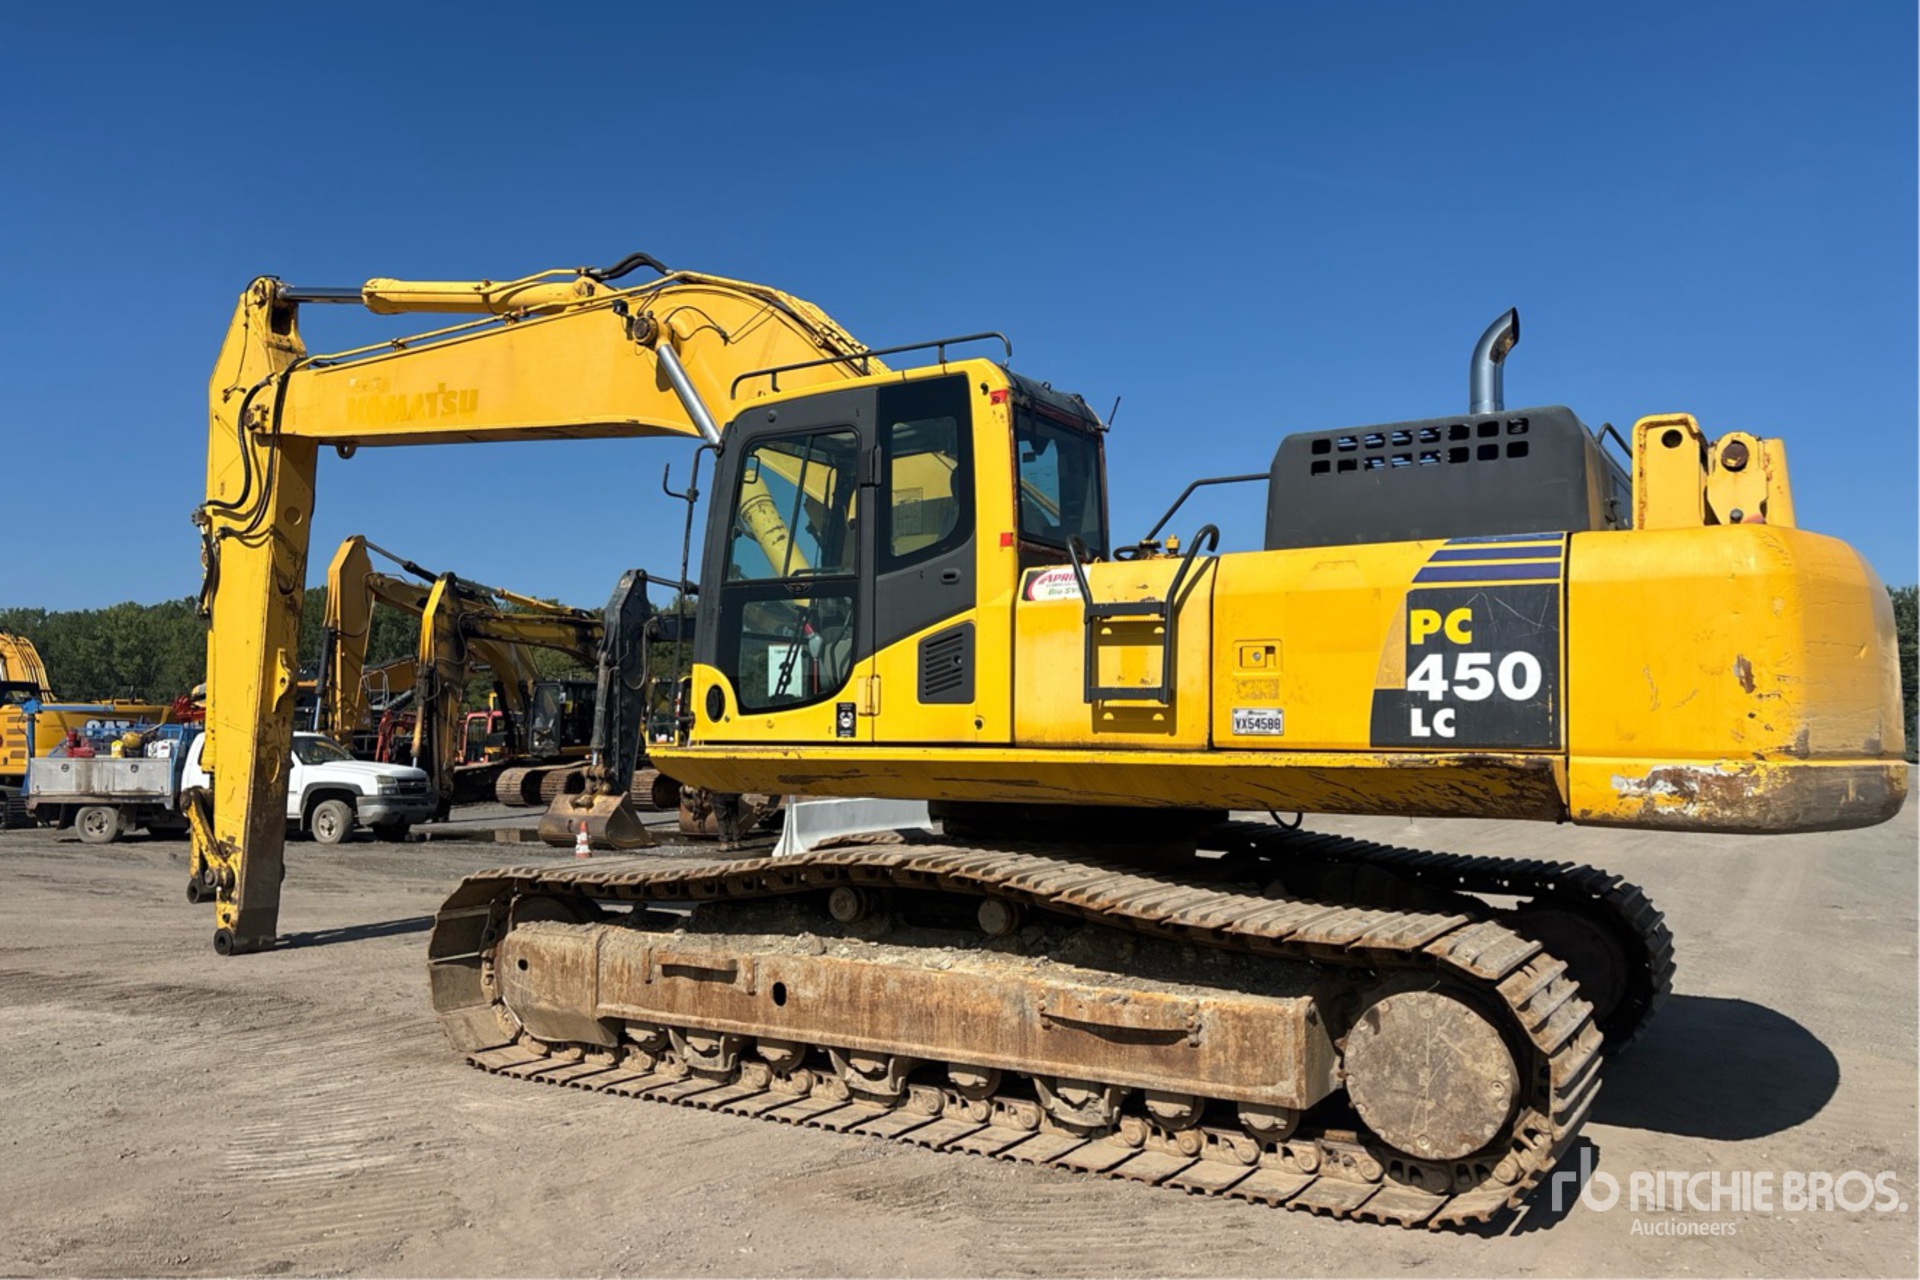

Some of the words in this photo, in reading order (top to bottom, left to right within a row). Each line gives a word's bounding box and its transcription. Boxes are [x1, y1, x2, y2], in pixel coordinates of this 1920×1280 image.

[347, 383, 479, 424] KOMATSU
[1410, 607, 1473, 646] PC
[1407, 650, 1542, 702] 450
[86, 720, 130, 737] CAT
[1235, 717, 1281, 731] VX54588
[1410, 708, 1456, 739] LC
